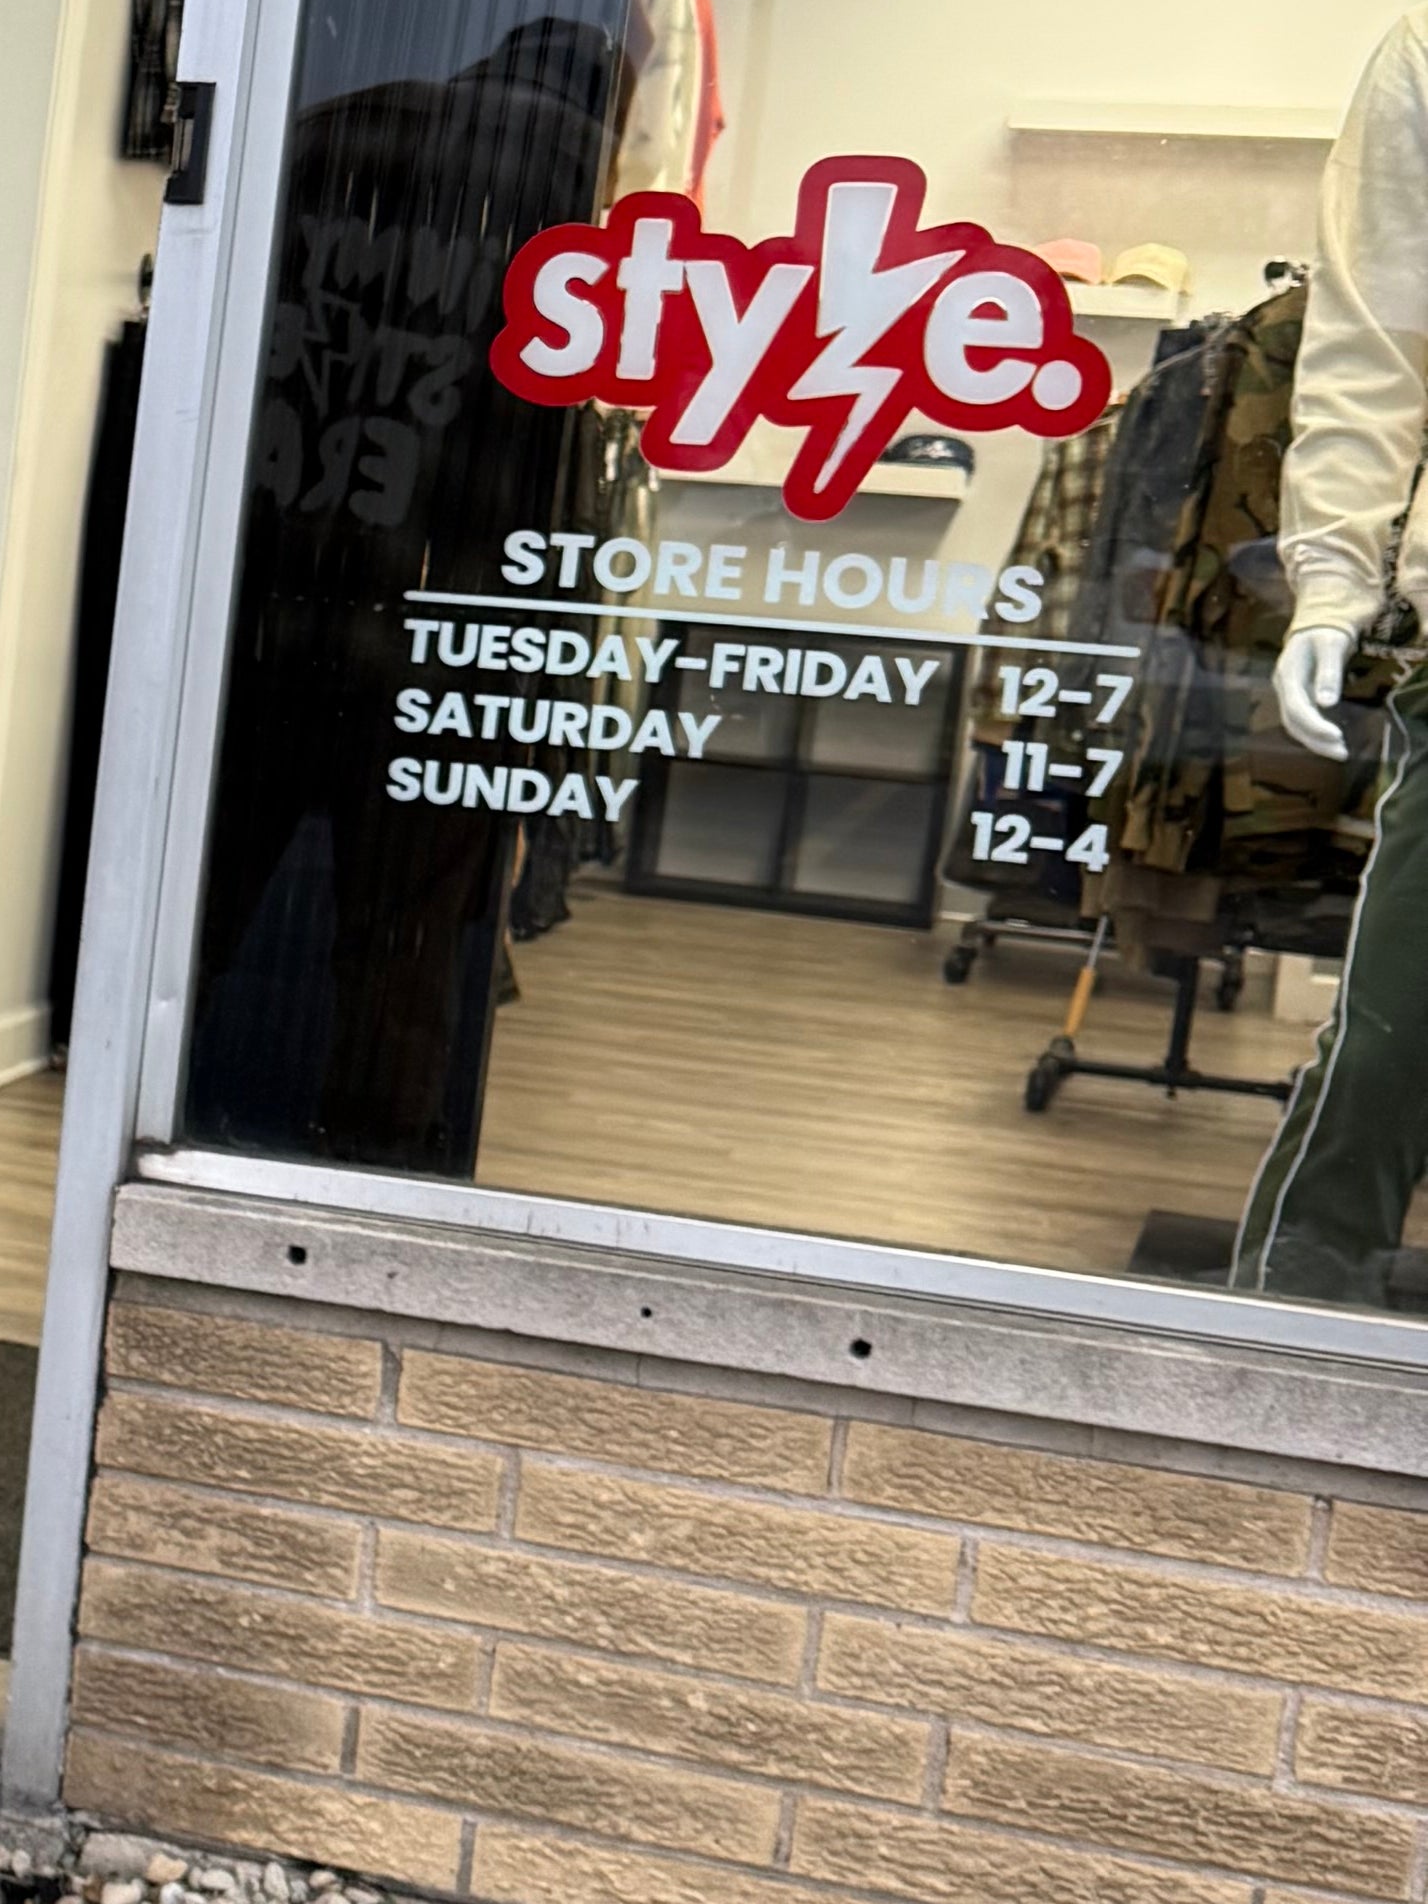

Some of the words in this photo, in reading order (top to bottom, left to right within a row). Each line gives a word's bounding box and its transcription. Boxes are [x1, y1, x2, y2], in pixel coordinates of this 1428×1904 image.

[500, 529, 747, 602] STORE
[763, 549, 1045, 624] HOURS
[403, 618, 941, 706] TUESDAY-FRIDAY
[998, 665, 1134, 725] 12-7
[394, 688, 722, 759] SATURDAY
[1001, 739, 1125, 799] 11-7
[386, 756, 640, 823] SUNDAY
[970, 811, 1110, 872] 12-4
